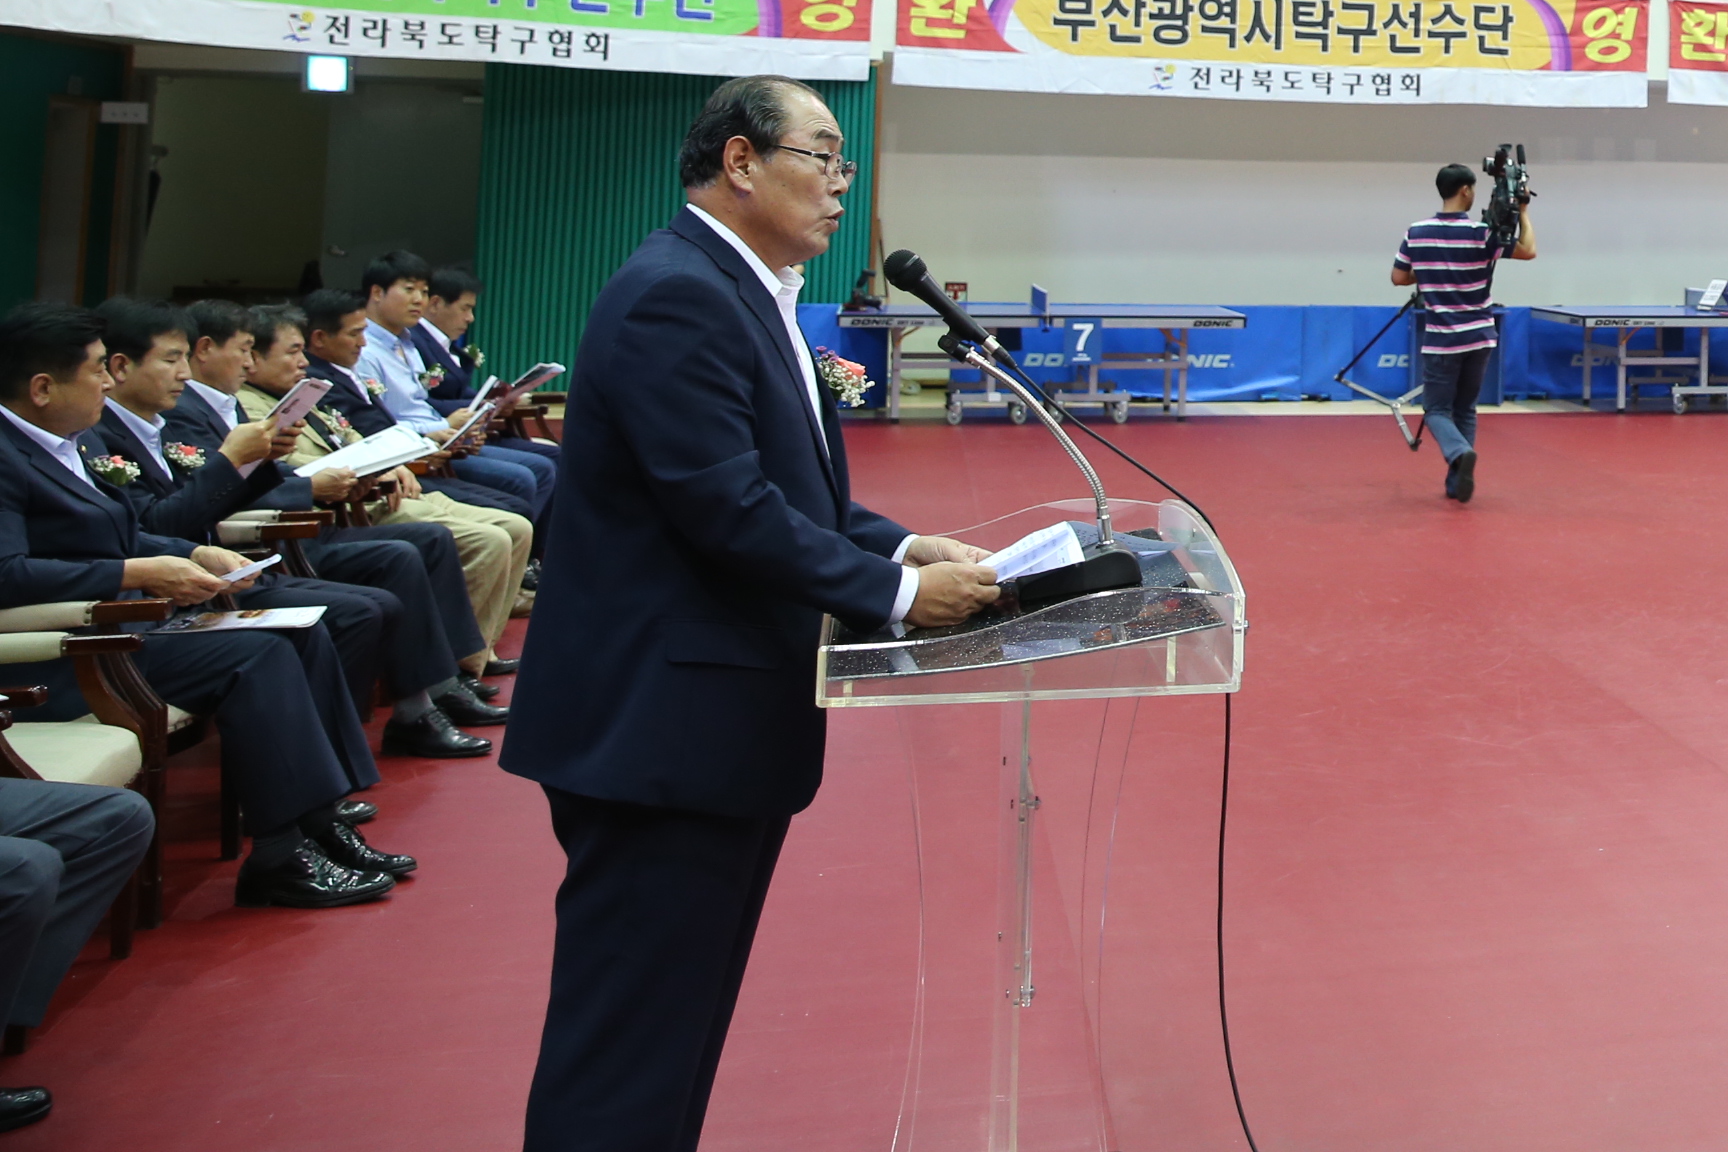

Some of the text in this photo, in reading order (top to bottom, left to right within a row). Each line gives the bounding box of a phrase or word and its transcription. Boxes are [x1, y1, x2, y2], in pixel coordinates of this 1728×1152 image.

[323, 14, 611, 61] 전라북도탁구협회
[1581, 6, 1640, 64] 영
[1188, 66, 1422, 97] 전라북도탁구협회
[850, 318, 895, 326] DONIC
[1072, 322, 1095, 352] 7
[1193, 319, 1234, 328] DONIC
[1594, 319, 1630, 327] DONIC
